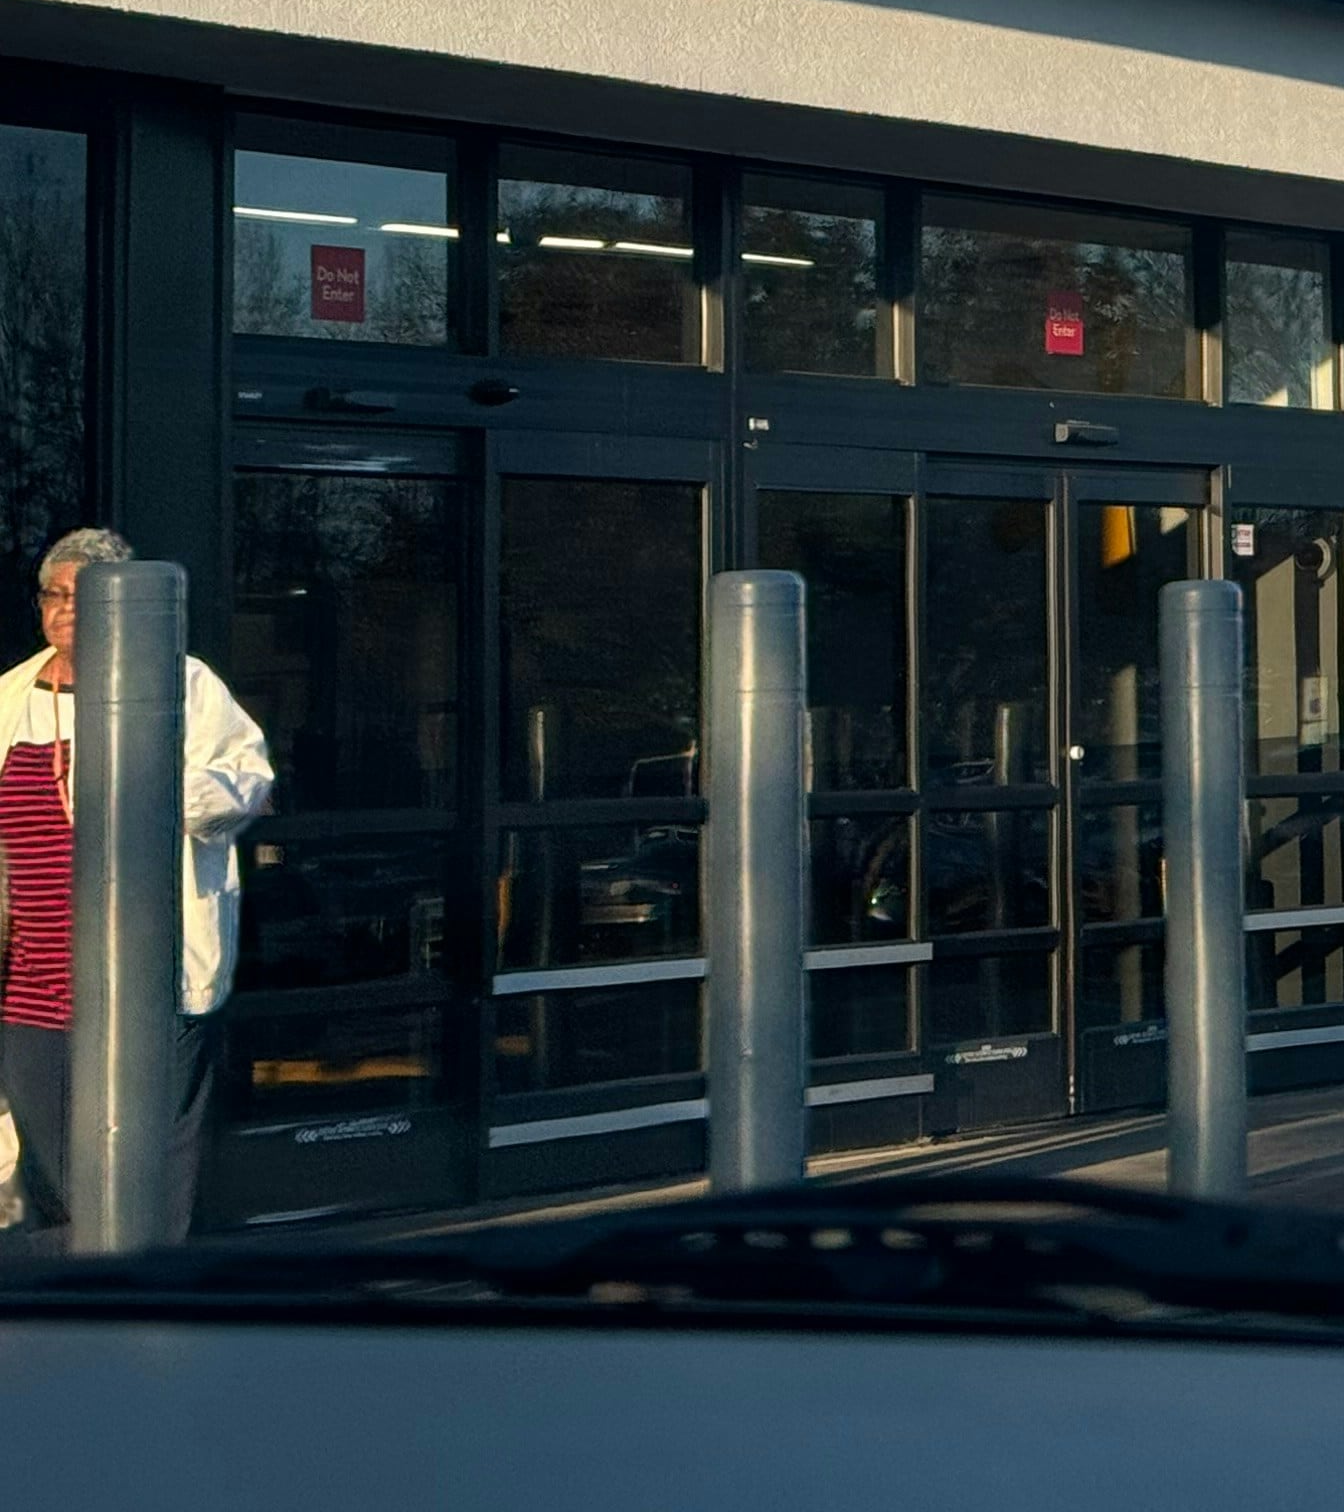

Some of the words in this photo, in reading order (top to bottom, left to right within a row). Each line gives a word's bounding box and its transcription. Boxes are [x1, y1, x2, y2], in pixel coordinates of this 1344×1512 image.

[317, 265, 334, 282] Do
[336, 268, 360, 285] Not
[322, 284, 354, 302] Enter
[1052, 323, 1076, 337] Enter
